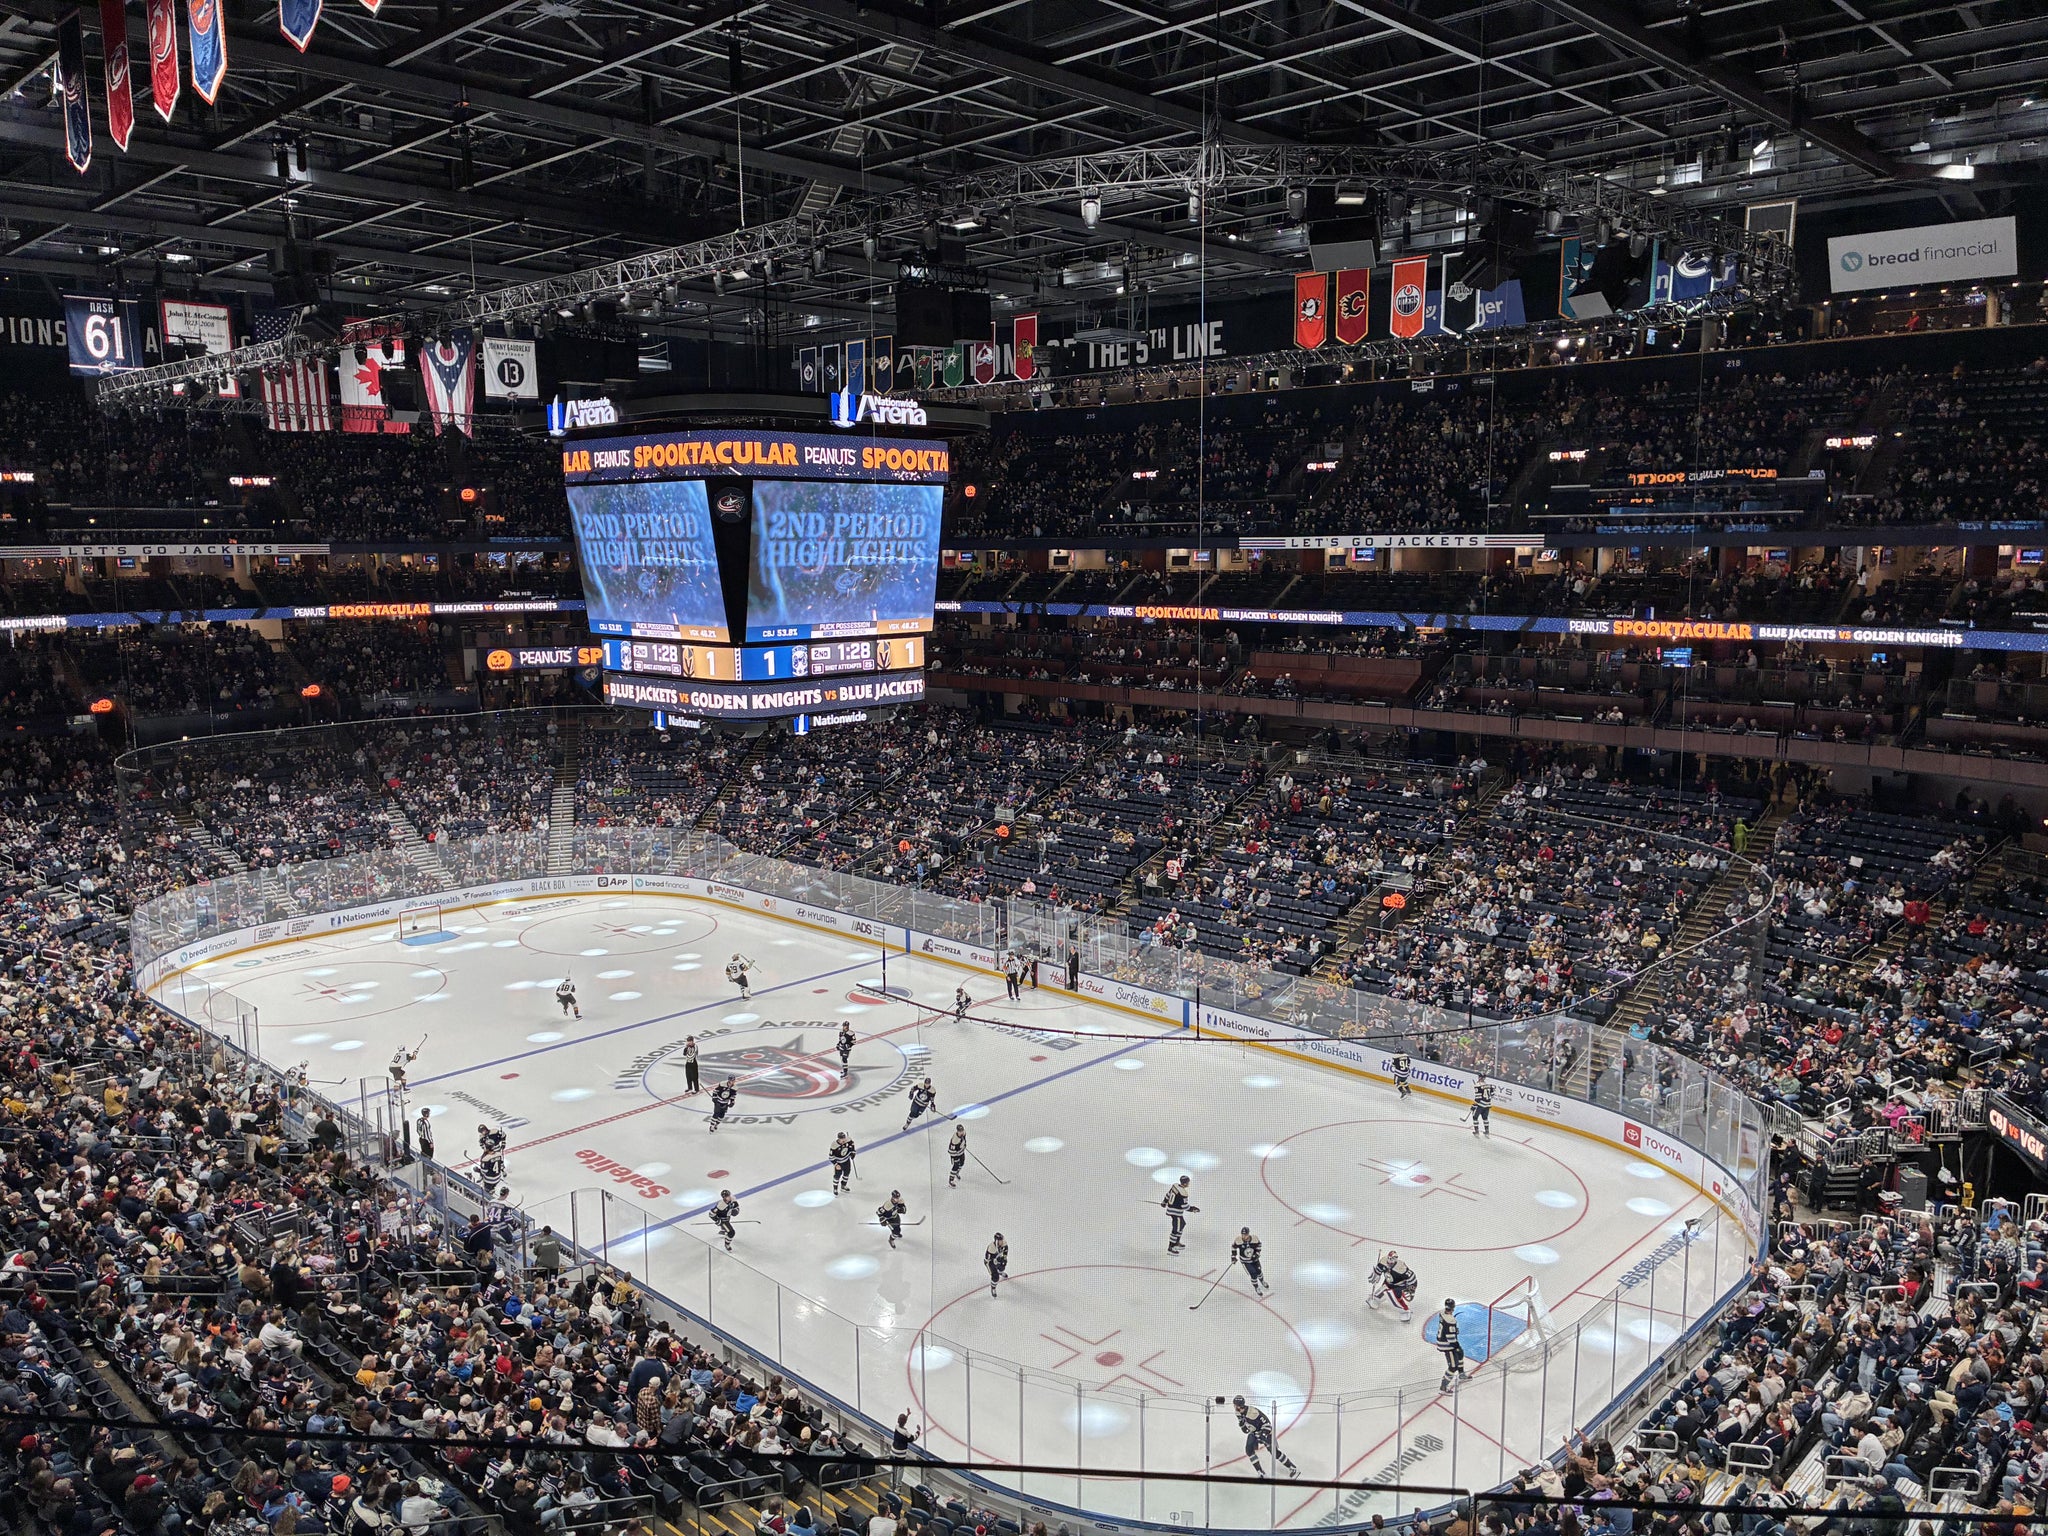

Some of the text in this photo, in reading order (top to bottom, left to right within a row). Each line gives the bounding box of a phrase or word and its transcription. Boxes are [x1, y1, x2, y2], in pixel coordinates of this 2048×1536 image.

[1868, 240, 1997, 267] bread financial
[89, 302, 114, 314] NASH
[167, 311, 184, 319] John
[84, 314, 125, 360] 61
[504, 362, 520, 384] 13
[1726, 360, 1741, 368] 218
[856, 395, 927, 426] Arena
[874, 395, 918, 409] Nationwide
[564, 400, 619, 429] Arena
[1826, 438, 1842, 447] CBJ
[1852, 437, 1873, 447] VGK
[594, 450, 631, 468] PEANUTS
[633, 441, 800, 468] SPOOKTACULAR
[804, 446, 857, 466] PEANUTS
[582, 512, 700, 540] 2ND PERIOD
[769, 511, 927, 539] 2ND PERIOD
[68, 545, 273, 556] LET'S GO JACKETS
[1291, 536, 1479, 547] LET'S GO JACKETS
[583, 541, 705, 567] HIGHLIGHTS
[766, 540, 929, 568] HIGHLIGHTS
[294, 607, 326, 617] PEANUTS
[328, 603, 431, 617] SPOOKTACULAR
[434, 604, 452, 613] BLUE
[452, 603, 484, 613] JACKETS
[494, 603, 523, 611] GOLDEN
[524, 600, 558, 612] KNIGHTS
[1108, 607, 1134, 617] PEANUTS
[1135, 606, 1220, 621] SPOOKTACULAR
[1223, 610, 1239, 619] BLUE
[1240, 611, 1268, 620] JACKETS
[1278, 612, 1307, 622] GOLDEN
[1308, 610, 1344, 624] KNIGHTS
[24, 615, 67, 629] KNIGHTS
[819, 622, 870, 631] PUCK POSSESSION
[762, 630, 775, 638] CBJ
[1569, 620, 1962, 647] PEANUTS SPOOKTACULAR BLUE JACKETS VS GOLDEN KNIGHTS
[520, 649, 572, 665] PEANUTS
[604, 643, 611, 666] 1
[652, 644, 678, 663] 1:28
[814, 642, 871, 661] 2ND 1:28
[905, 641, 914, 665] 1
[706, 650, 716, 676] 1
[763, 650, 775, 676] 1
[837, 662, 862, 671] ATTEMPTS
[610, 683, 635, 698] BLUE
[634, 684, 678, 705] JACKETS
[678, 692, 690, 704] VS
[691, 691, 748, 710] GOLDEN
[752, 689, 822, 710] KNIGHTS
[824, 690, 838, 701] VS
[839, 685, 873, 702] BLUE
[874, 679, 924, 702] JACKETS
[812, 711, 867, 727] Nationwide
[492, 886, 524, 896] Sportsbook
[531, 881, 566, 892] BLACK BOX
[645, 880, 690, 890] bread financial
[714, 885, 745, 899] SPARTAN
[342, 907, 391, 923] Nationwide
[807, 911, 837, 925] HYUNDAI
[189, 937, 238, 959] bread financial
[1115, 986, 1150, 1006] Surfside
[1218, 1017, 1272, 1038] Nationwide
[1310, 1041, 1363, 1063] OhioHealth
[450, 1090, 514, 1122] Nationwide
[1518, 1091, 1561, 1110] VORYS
[1989, 1109, 2008, 1136] CBJ
[2019, 1128, 2046, 1161] VGK
[1644, 1135, 1683, 1164] TOYOTA
[574, 1148, 671, 1200] Safelite
[349, 1247, 358, 1263] 8
